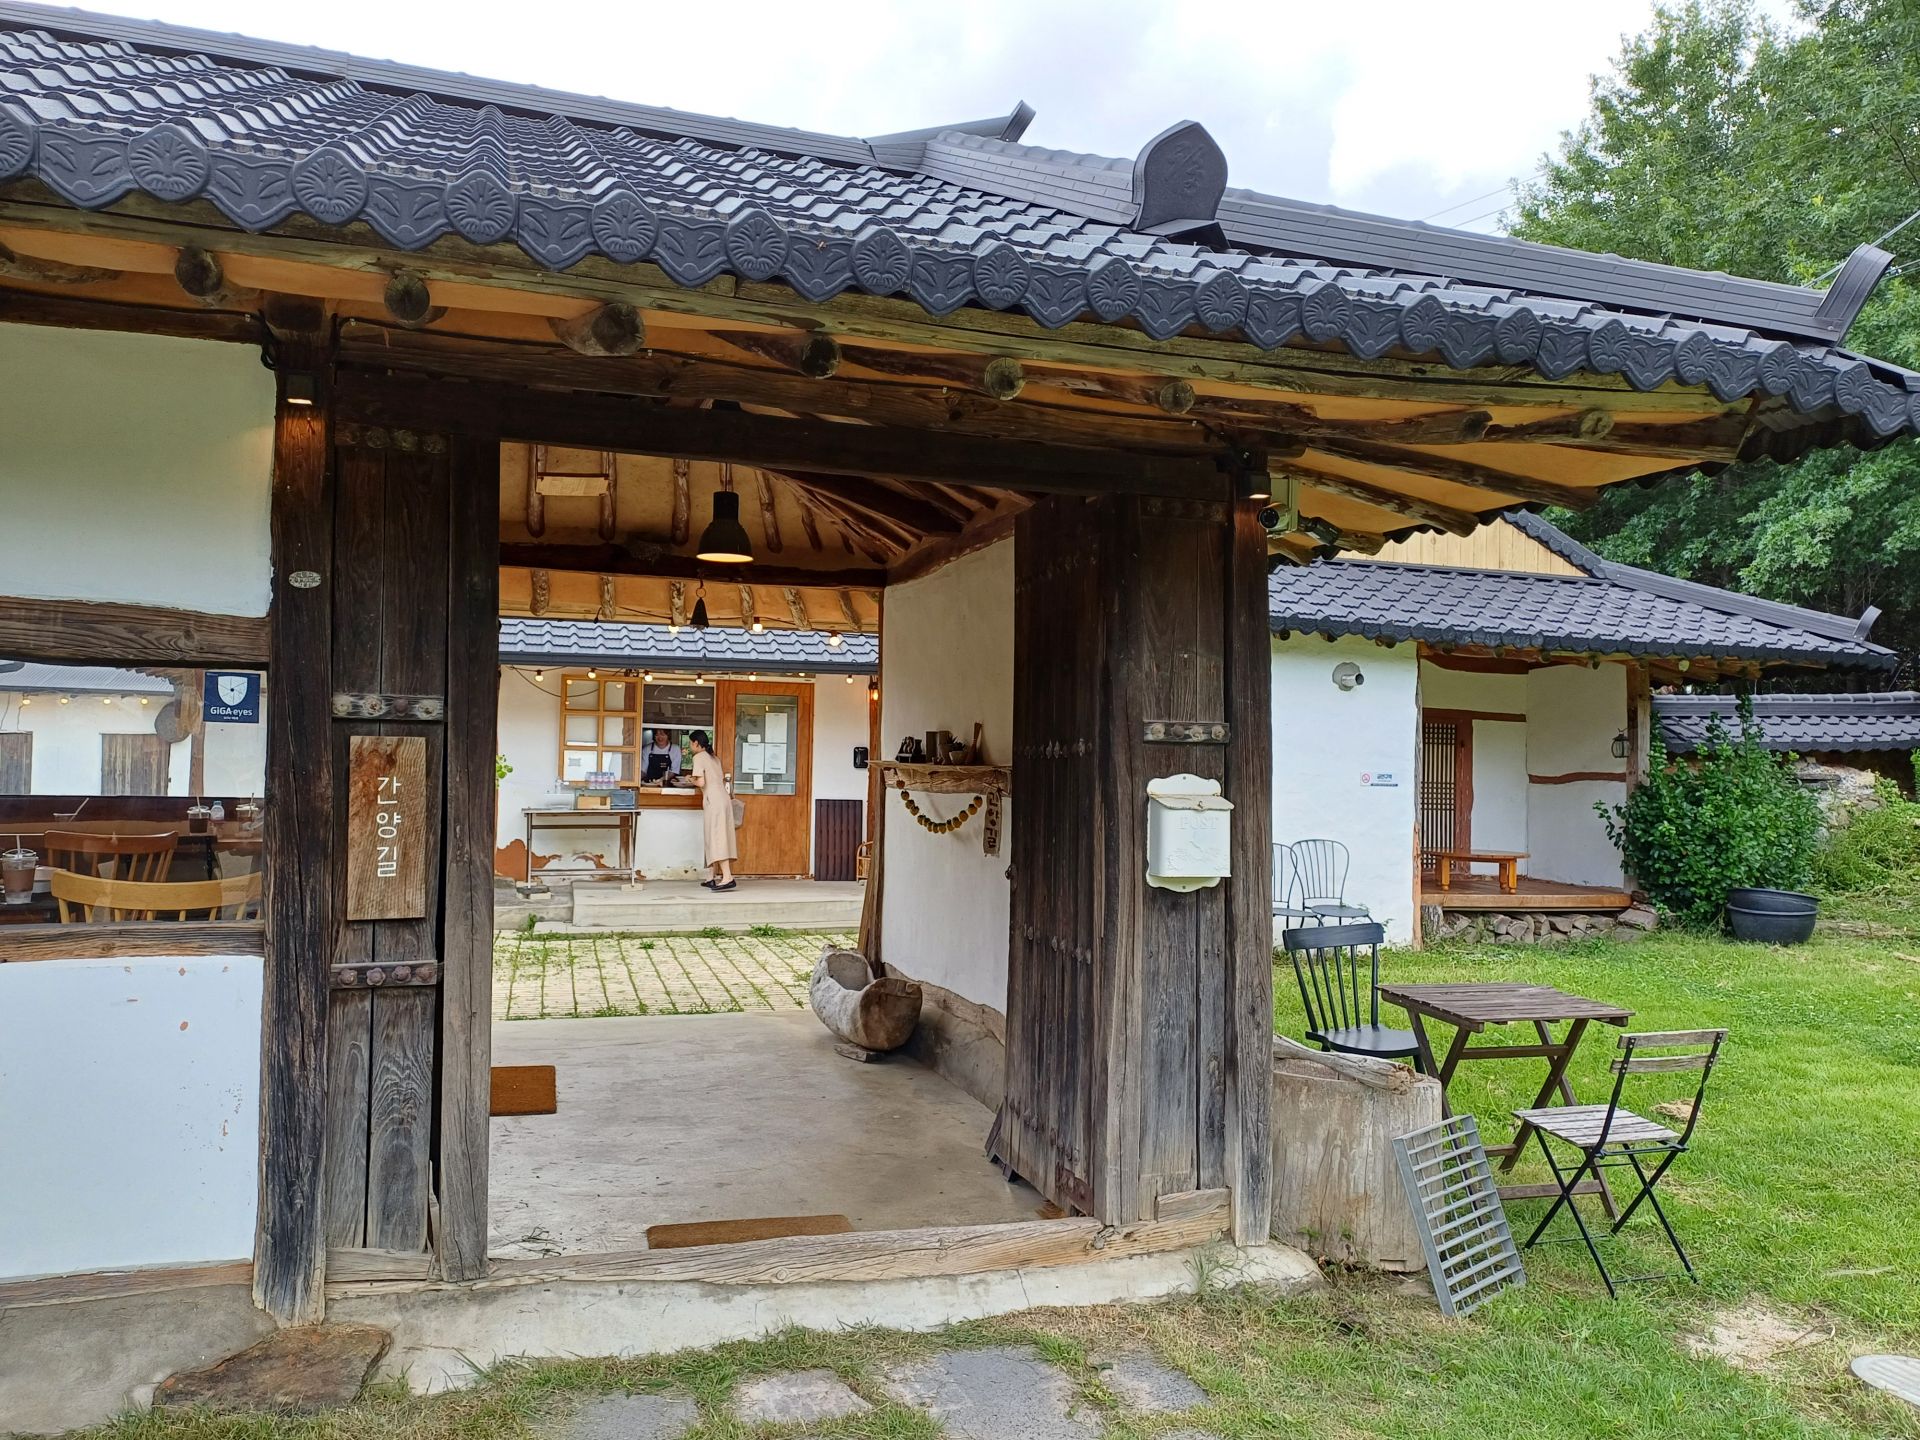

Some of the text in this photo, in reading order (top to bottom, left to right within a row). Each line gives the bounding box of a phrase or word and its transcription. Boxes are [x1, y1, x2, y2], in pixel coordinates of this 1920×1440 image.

[233, 709, 253, 717] eyes
[376, 775, 402, 878] 간양길
[1180, 816, 1219, 828] POST
